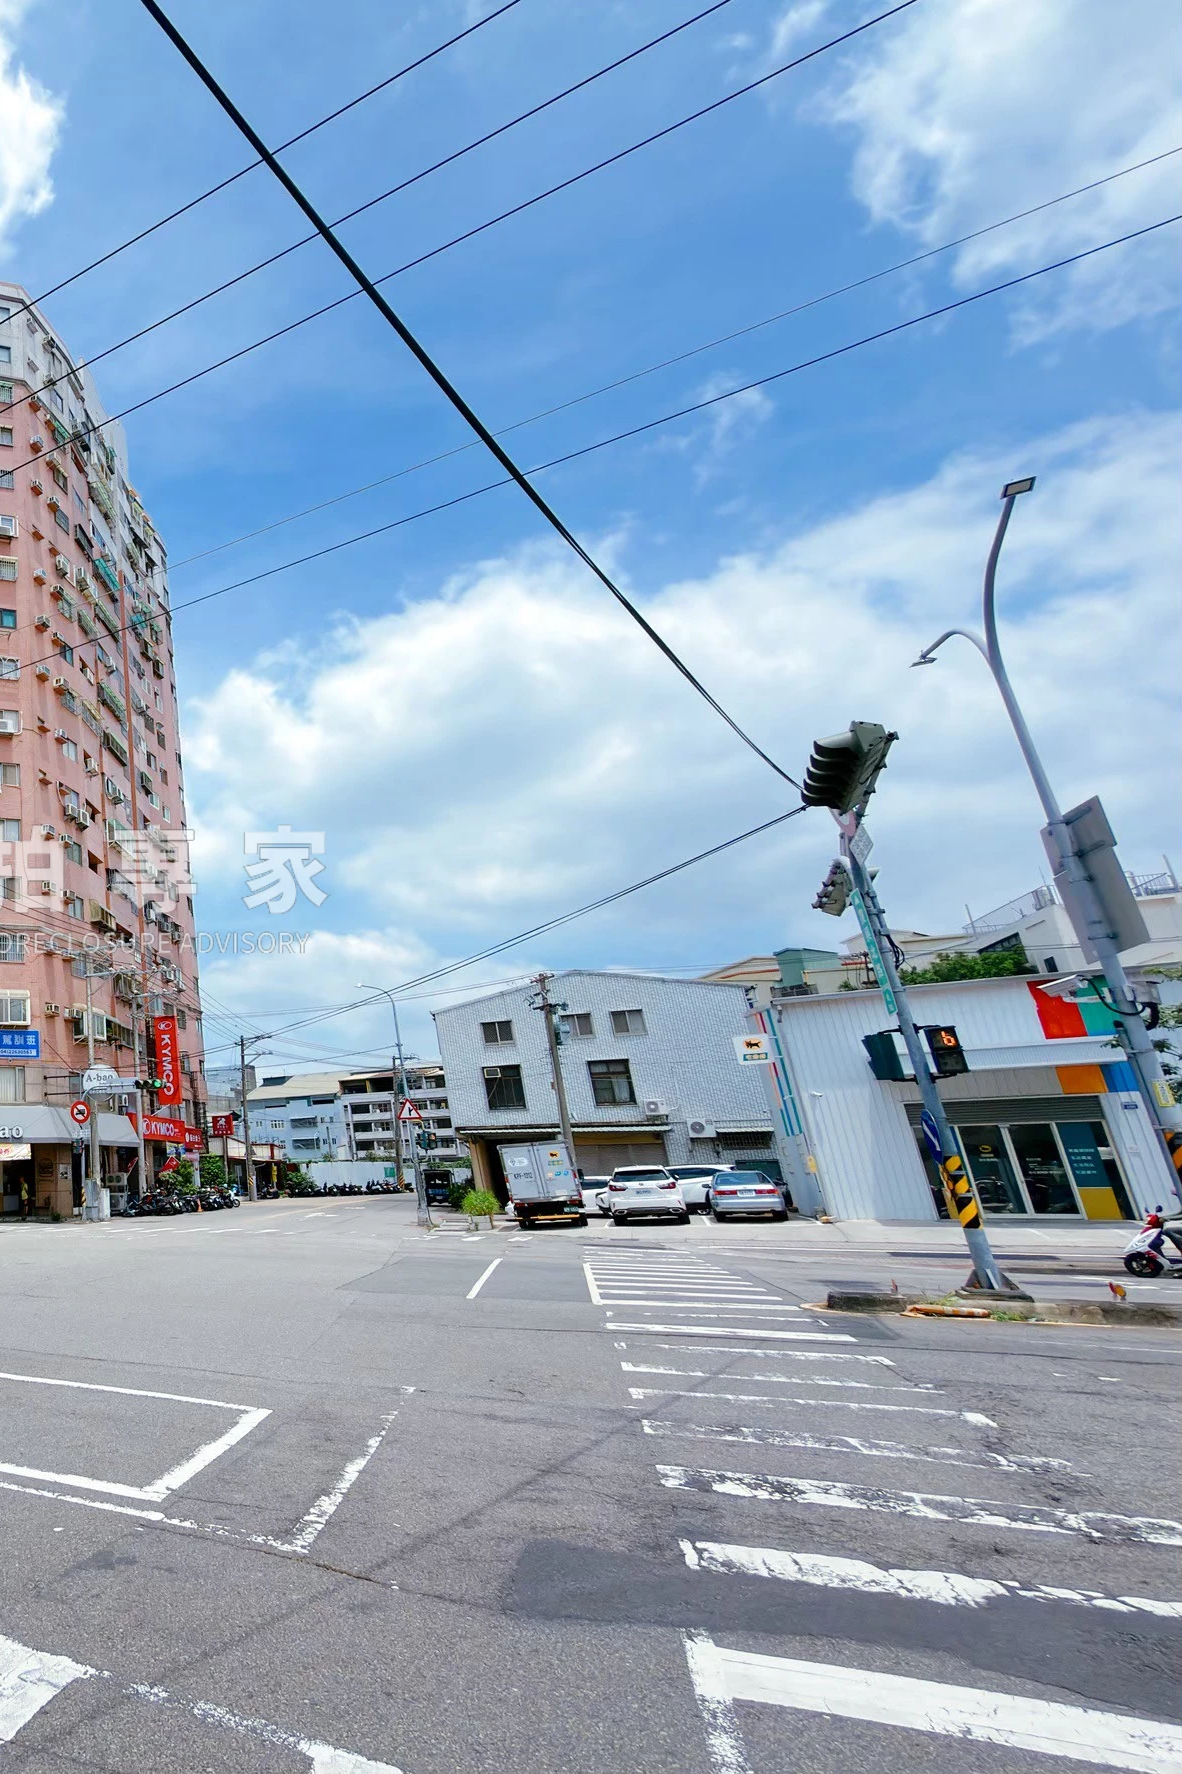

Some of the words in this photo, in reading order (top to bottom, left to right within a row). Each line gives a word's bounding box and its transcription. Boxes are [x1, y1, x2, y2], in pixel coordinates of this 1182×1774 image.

[2, 1034, 36, 1046] 駕訓班
[160, 1034, 174, 1096] KYMCO
[151, 1121, 175, 1137] KYMCO
